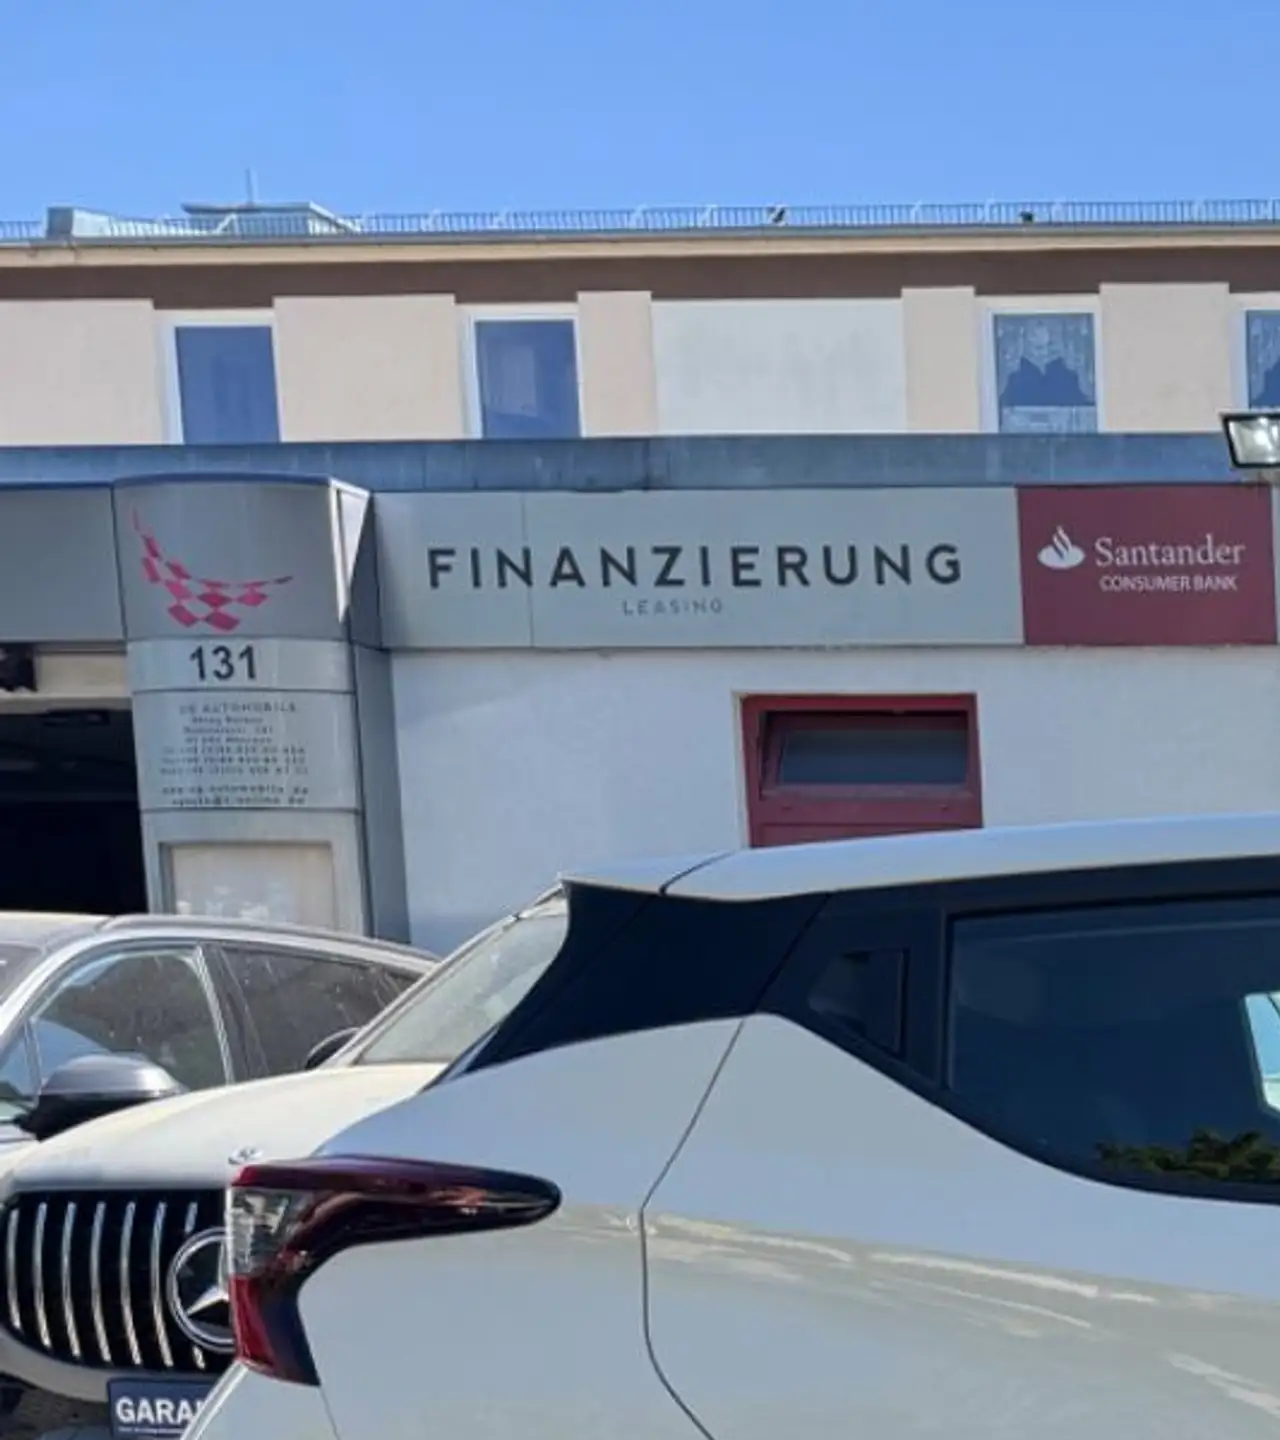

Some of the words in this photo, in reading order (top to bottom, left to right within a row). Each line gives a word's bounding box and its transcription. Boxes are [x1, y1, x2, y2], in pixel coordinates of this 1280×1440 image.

[427, 543, 962, 590] FINANZIERUNG
[1094, 533, 1247, 568] Santander
[1099, 574, 1190, 593] CONSUMER
[1194, 574, 1239, 591] BANK
[620, 597, 724, 617] LEASING
[189, 644, 257, 682] 131
